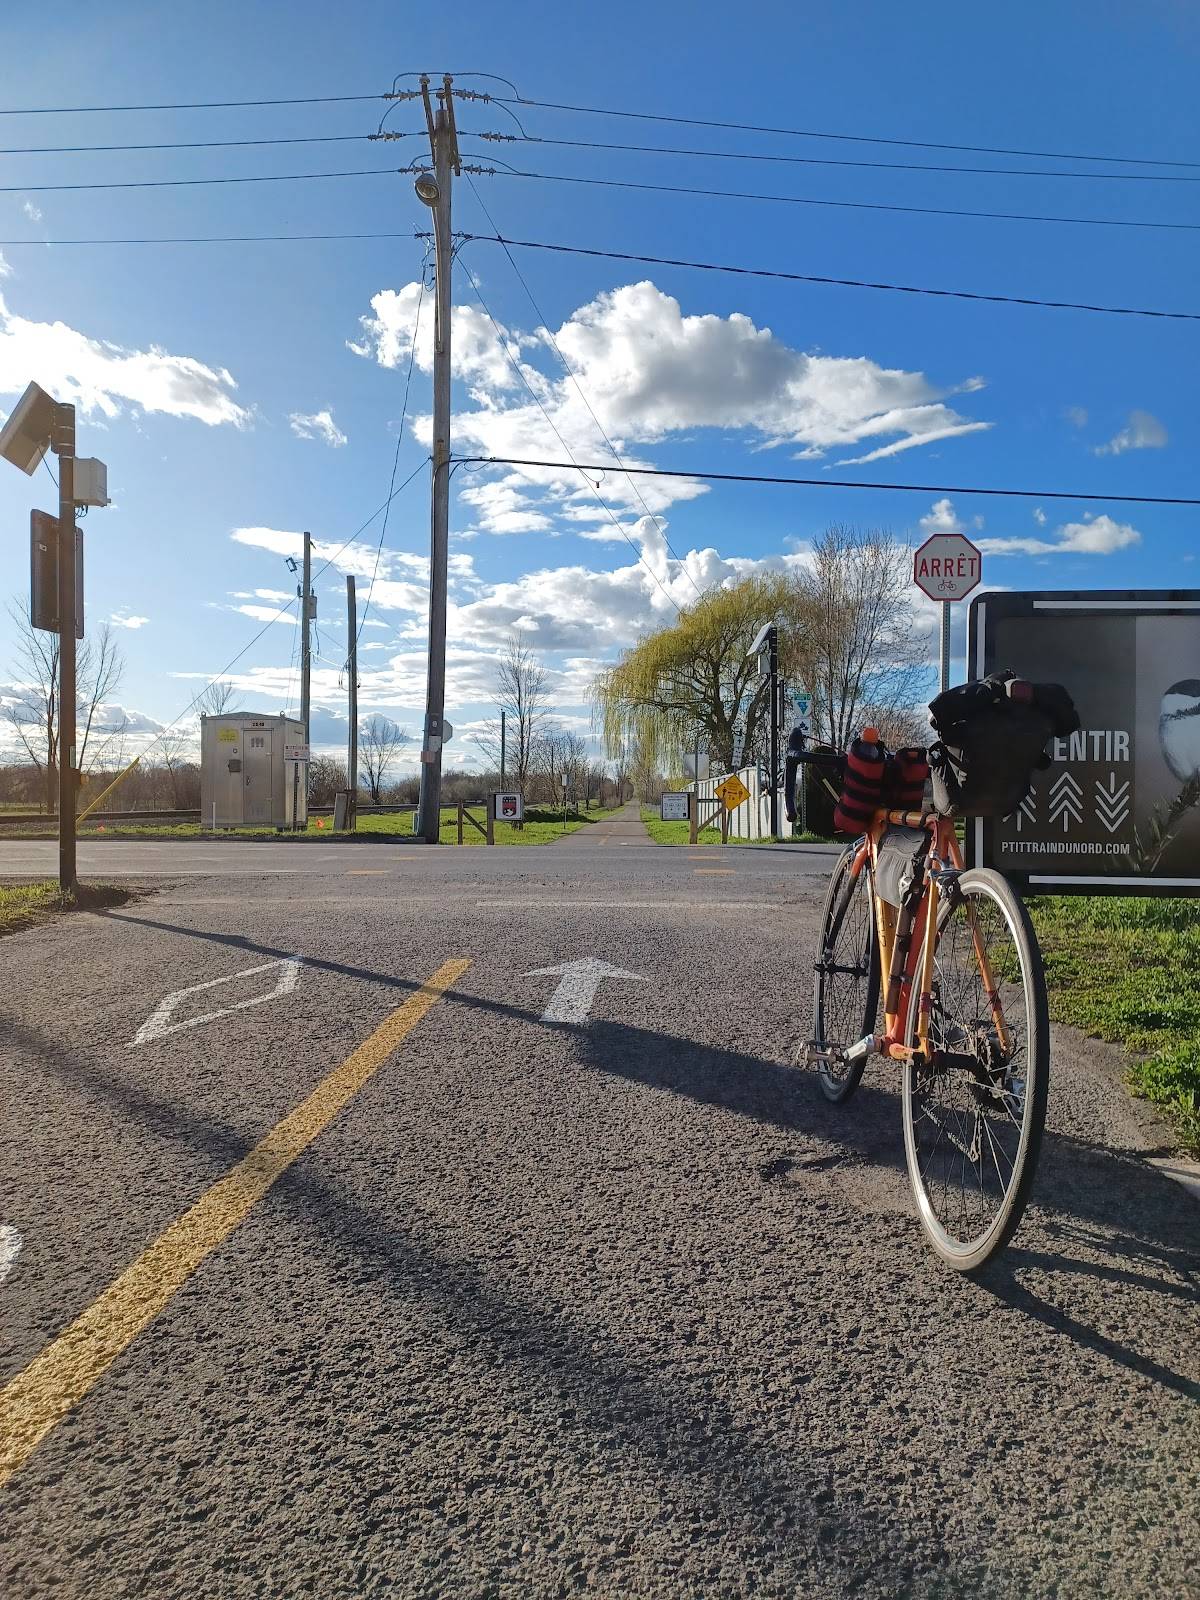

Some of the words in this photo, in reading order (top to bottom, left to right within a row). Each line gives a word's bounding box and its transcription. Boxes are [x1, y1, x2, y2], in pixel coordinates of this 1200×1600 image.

[918, 552, 977, 577] ARRÊT
[1048, 730, 1130, 761] ENTIR
[1001, 841, 1130, 855] PTITTRAINDUNORD.COM
